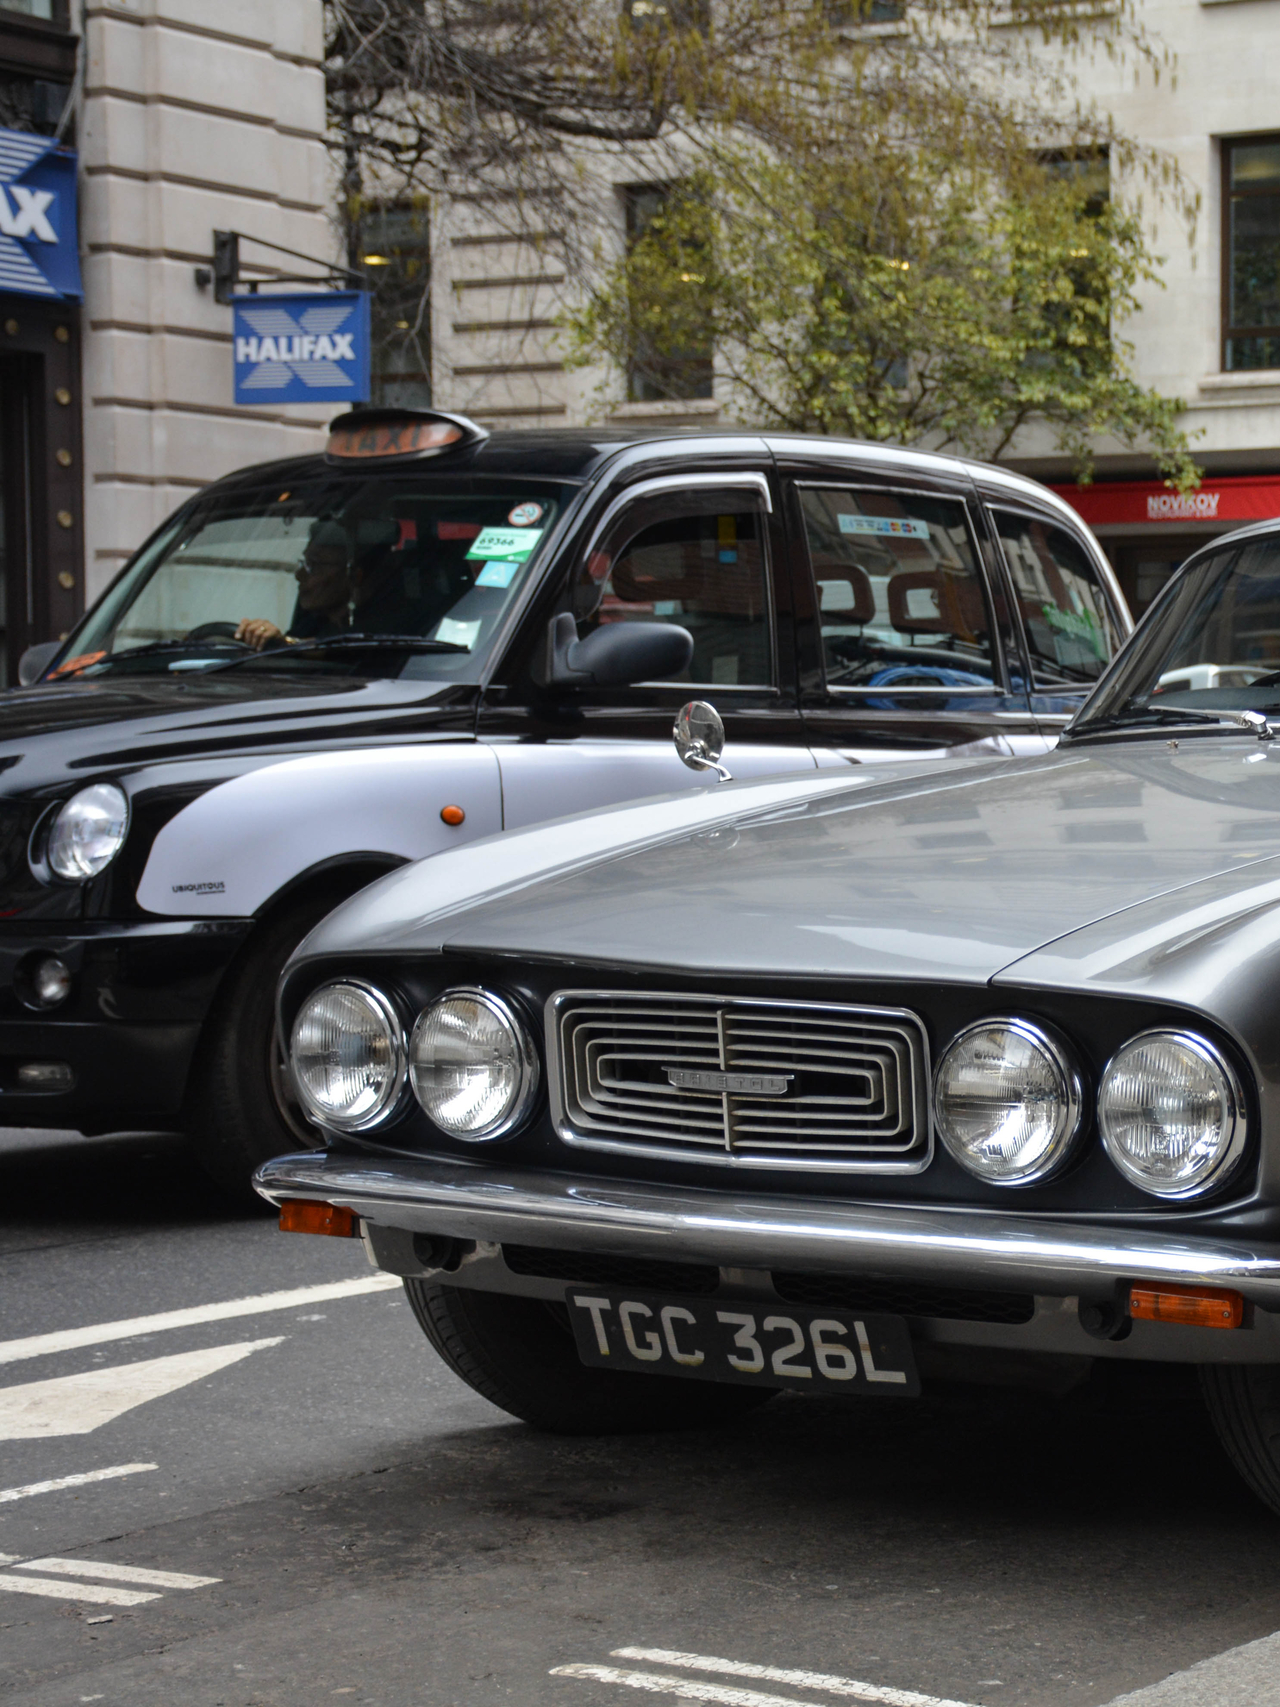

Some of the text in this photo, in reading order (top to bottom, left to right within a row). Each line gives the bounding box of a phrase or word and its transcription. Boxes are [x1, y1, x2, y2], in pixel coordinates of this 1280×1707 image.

[236, 333, 356, 363] HALIFAX
[342, 424, 422, 453] TAXI
[1147, 493, 1219, 511] NOVIKOV
[172, 881, 225, 893] UBIQUITOUS
[674, 1072, 781, 1091] BRISTOL
[573, 1295, 907, 1384] TGC 326L
